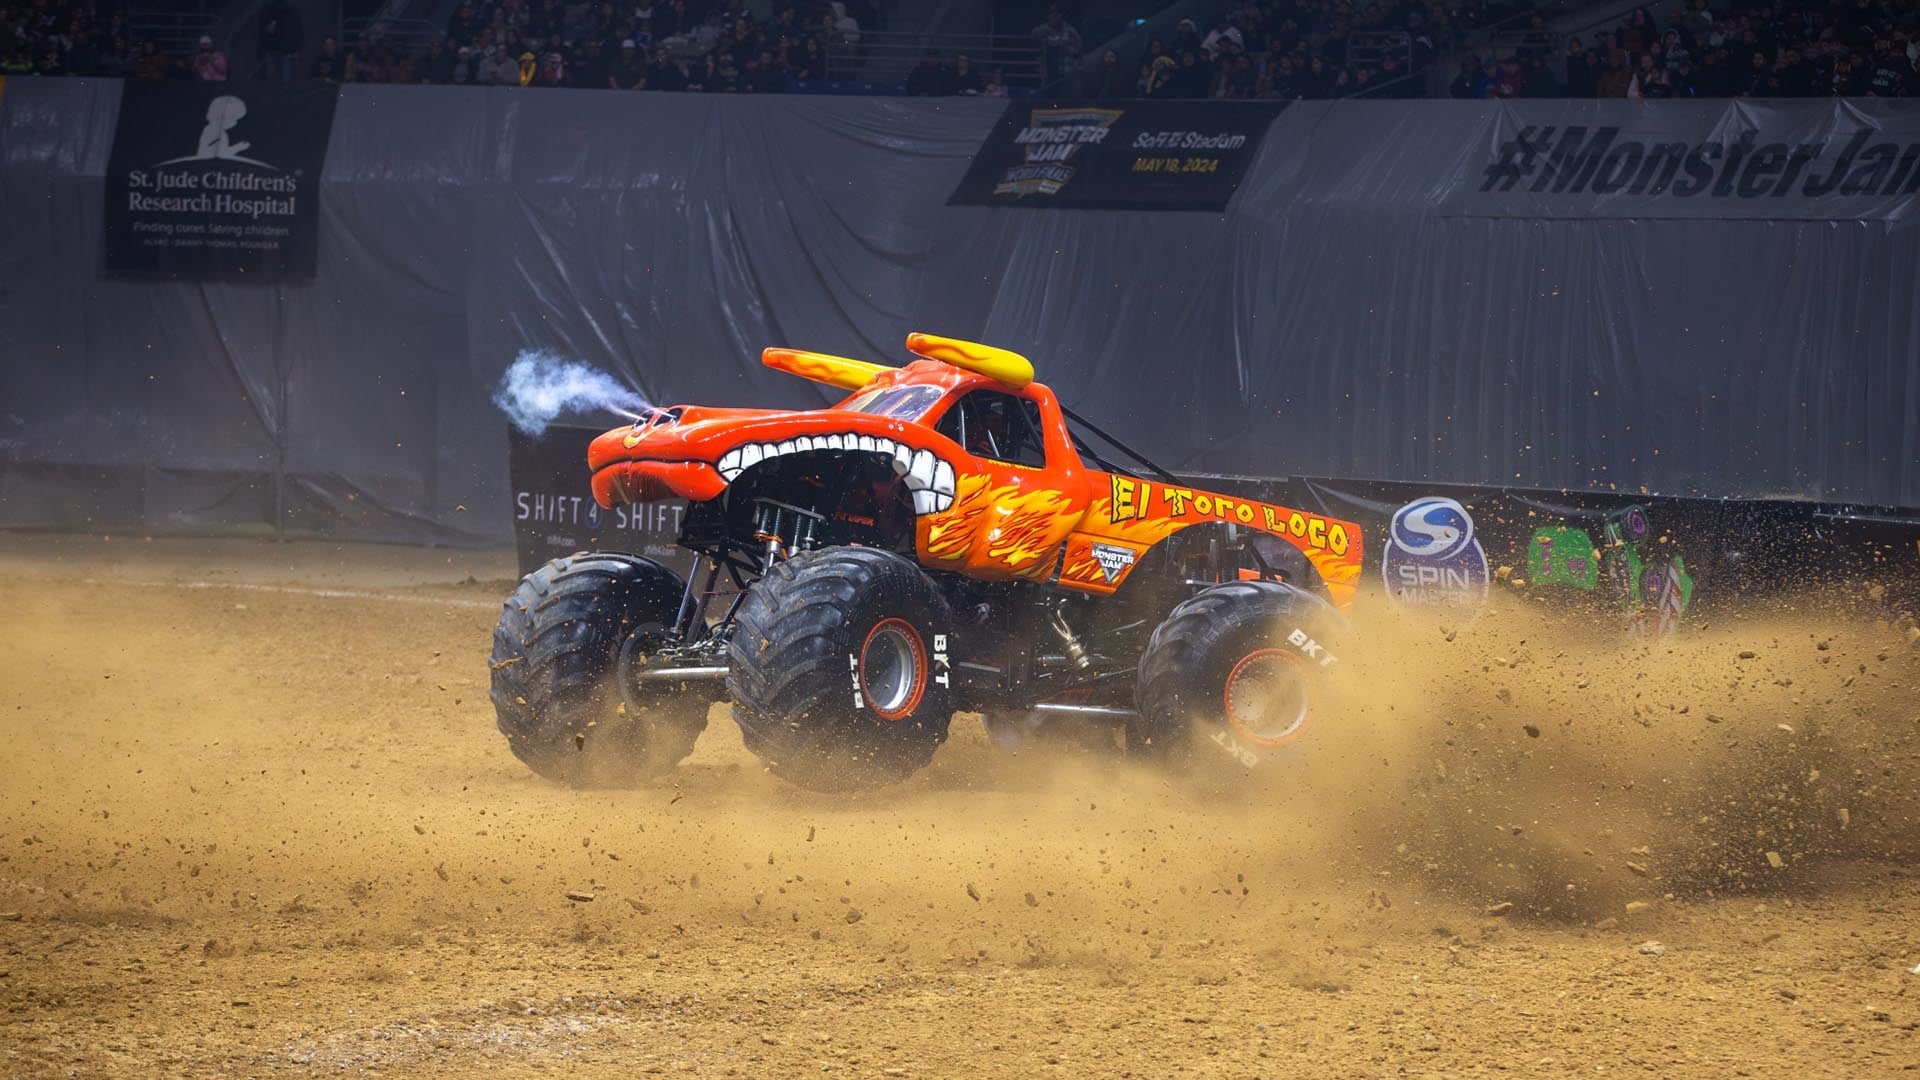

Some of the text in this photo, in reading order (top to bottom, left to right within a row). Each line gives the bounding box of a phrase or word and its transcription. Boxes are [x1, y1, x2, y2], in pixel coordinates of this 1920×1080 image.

[1014, 126, 1111, 144] MONSTER
[1180, 131, 1246, 150] Stadium
[1027, 143, 1074, 161] JAM
[1132, 156, 1164, 173] MAY
[1182, 157, 1219, 173] 2024
[128, 170, 297, 193] St. Jude Children's
[128, 191, 296, 220] Research Hospital
[133, 221, 174, 235] Finding
[207, 223, 243, 238] Saving
[1091, 549, 1134, 565] MONSTER
[1101, 559, 1123, 570] JAM
[1398, 565, 1470, 592] SPIN
[1287, 628, 1339, 668] BKT
[933, 634, 951, 690] BKT
[849, 653, 865, 709] BKT
[1209, 730, 1259, 768] BKT
